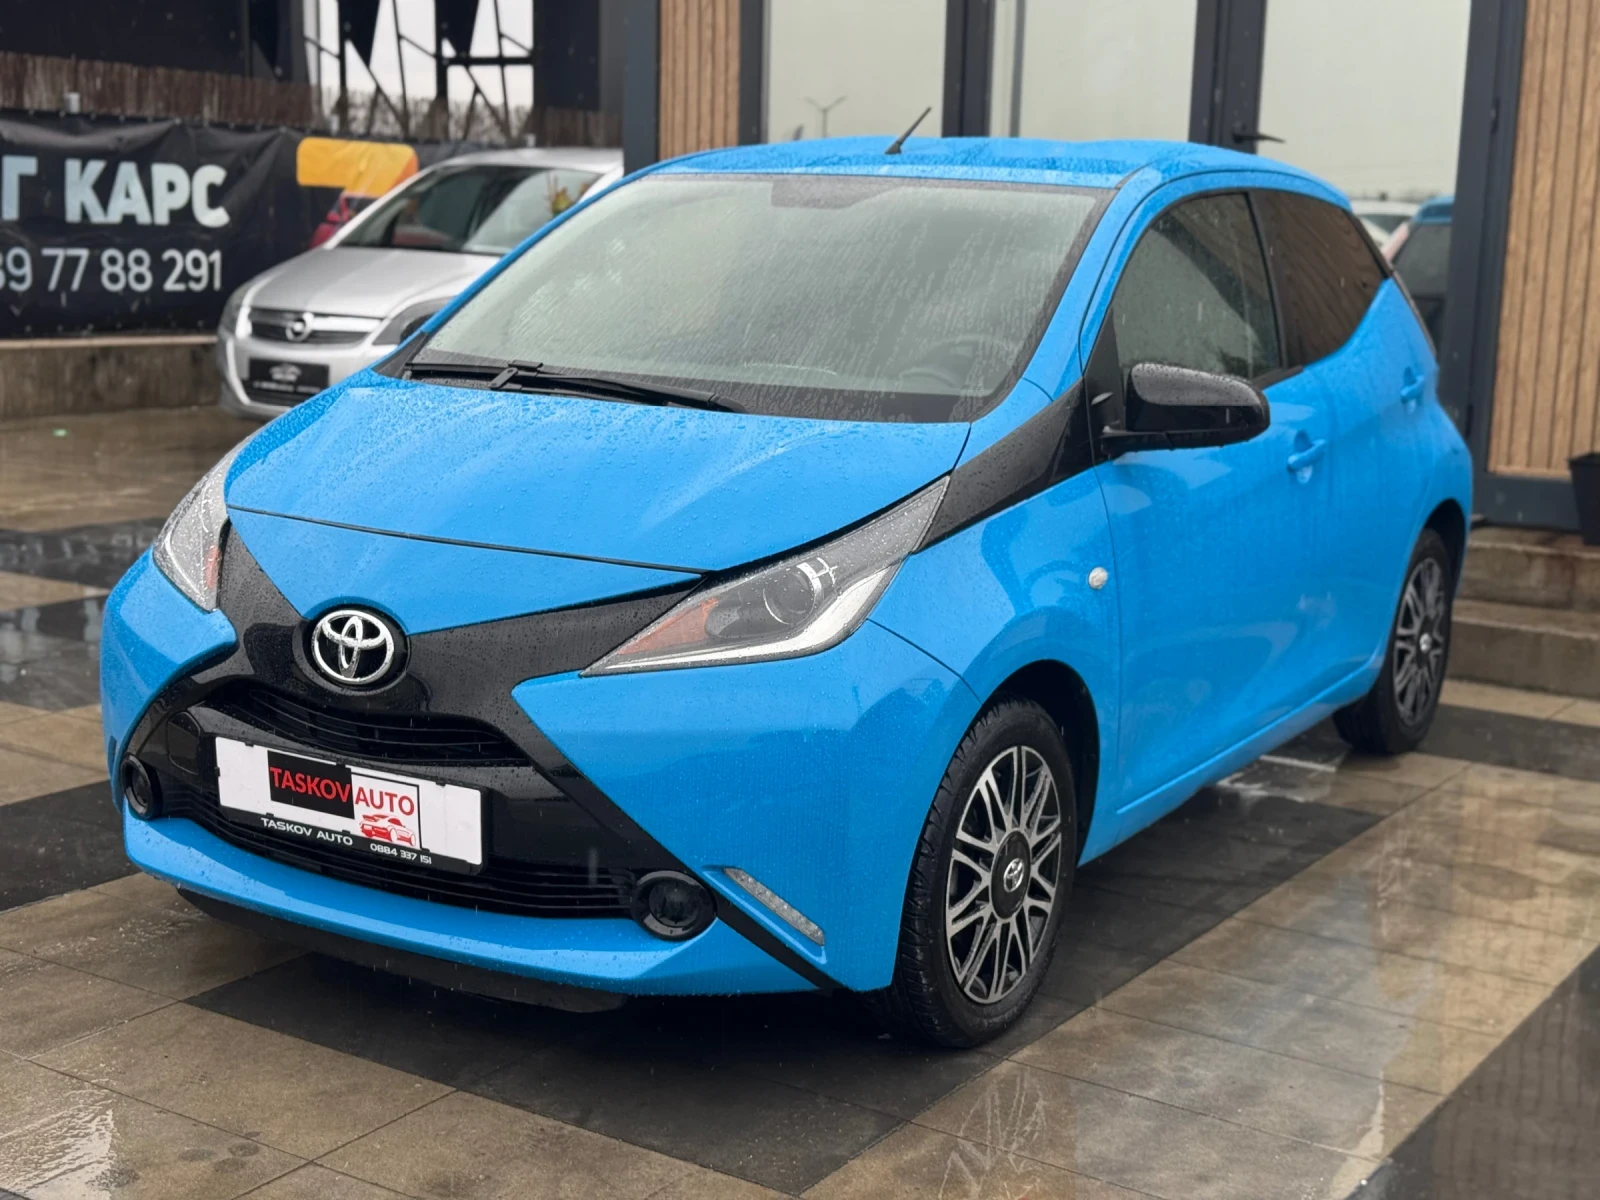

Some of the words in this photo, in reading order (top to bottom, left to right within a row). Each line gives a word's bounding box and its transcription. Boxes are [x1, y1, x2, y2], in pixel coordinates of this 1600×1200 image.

[65, 158, 230, 227] КАРС
[0, 247, 33, 292] 9
[41, 248, 89, 291] 77
[100, 249, 152, 292] 88
[162, 249, 222, 291] 291
[270, 767, 350, 802] TASKOV
[355, 787, 414, 815] AUTO
[261, 817, 312, 836] TASKOV
[316, 831, 353, 845] AUTO
[370, 843, 398, 856] 0884
[400, 850, 417, 860] 337
